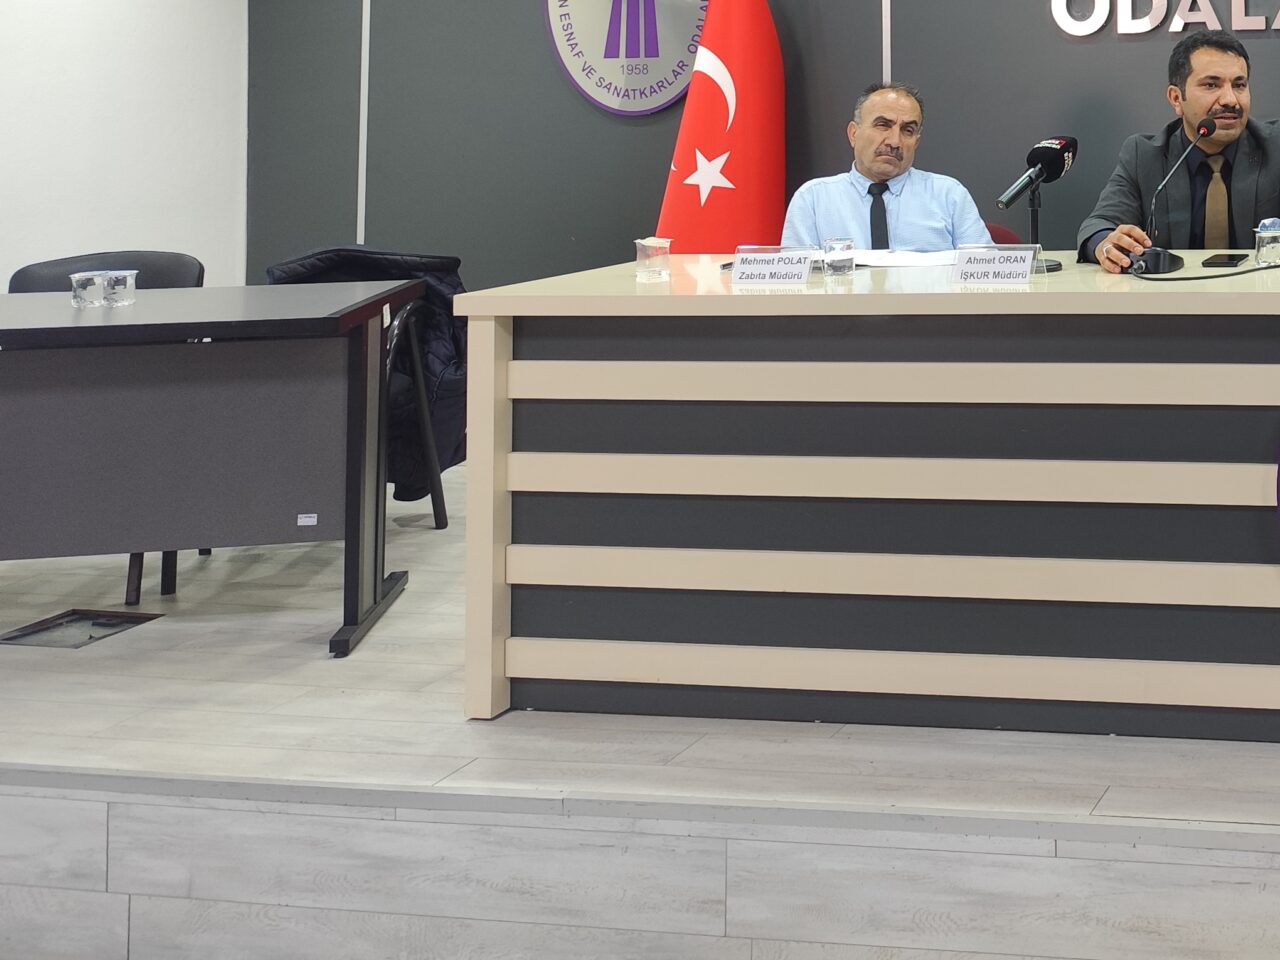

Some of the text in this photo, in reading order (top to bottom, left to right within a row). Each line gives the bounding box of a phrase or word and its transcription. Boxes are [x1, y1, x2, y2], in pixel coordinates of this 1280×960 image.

[559, 12, 584, 60] ESNAF
[581, 60, 597, 80] VE
[595, 59, 689, 100] SANATKARLAR
[619, 63, 648, 76] 1958
[740, 256, 808, 265] Mehmet POLAT
[966, 255, 1027, 264] Ahmet ORAN
[738, 271, 803, 280] Zabıta Müdürü
[960, 269, 1028, 281] İŞKUR Müdürü
